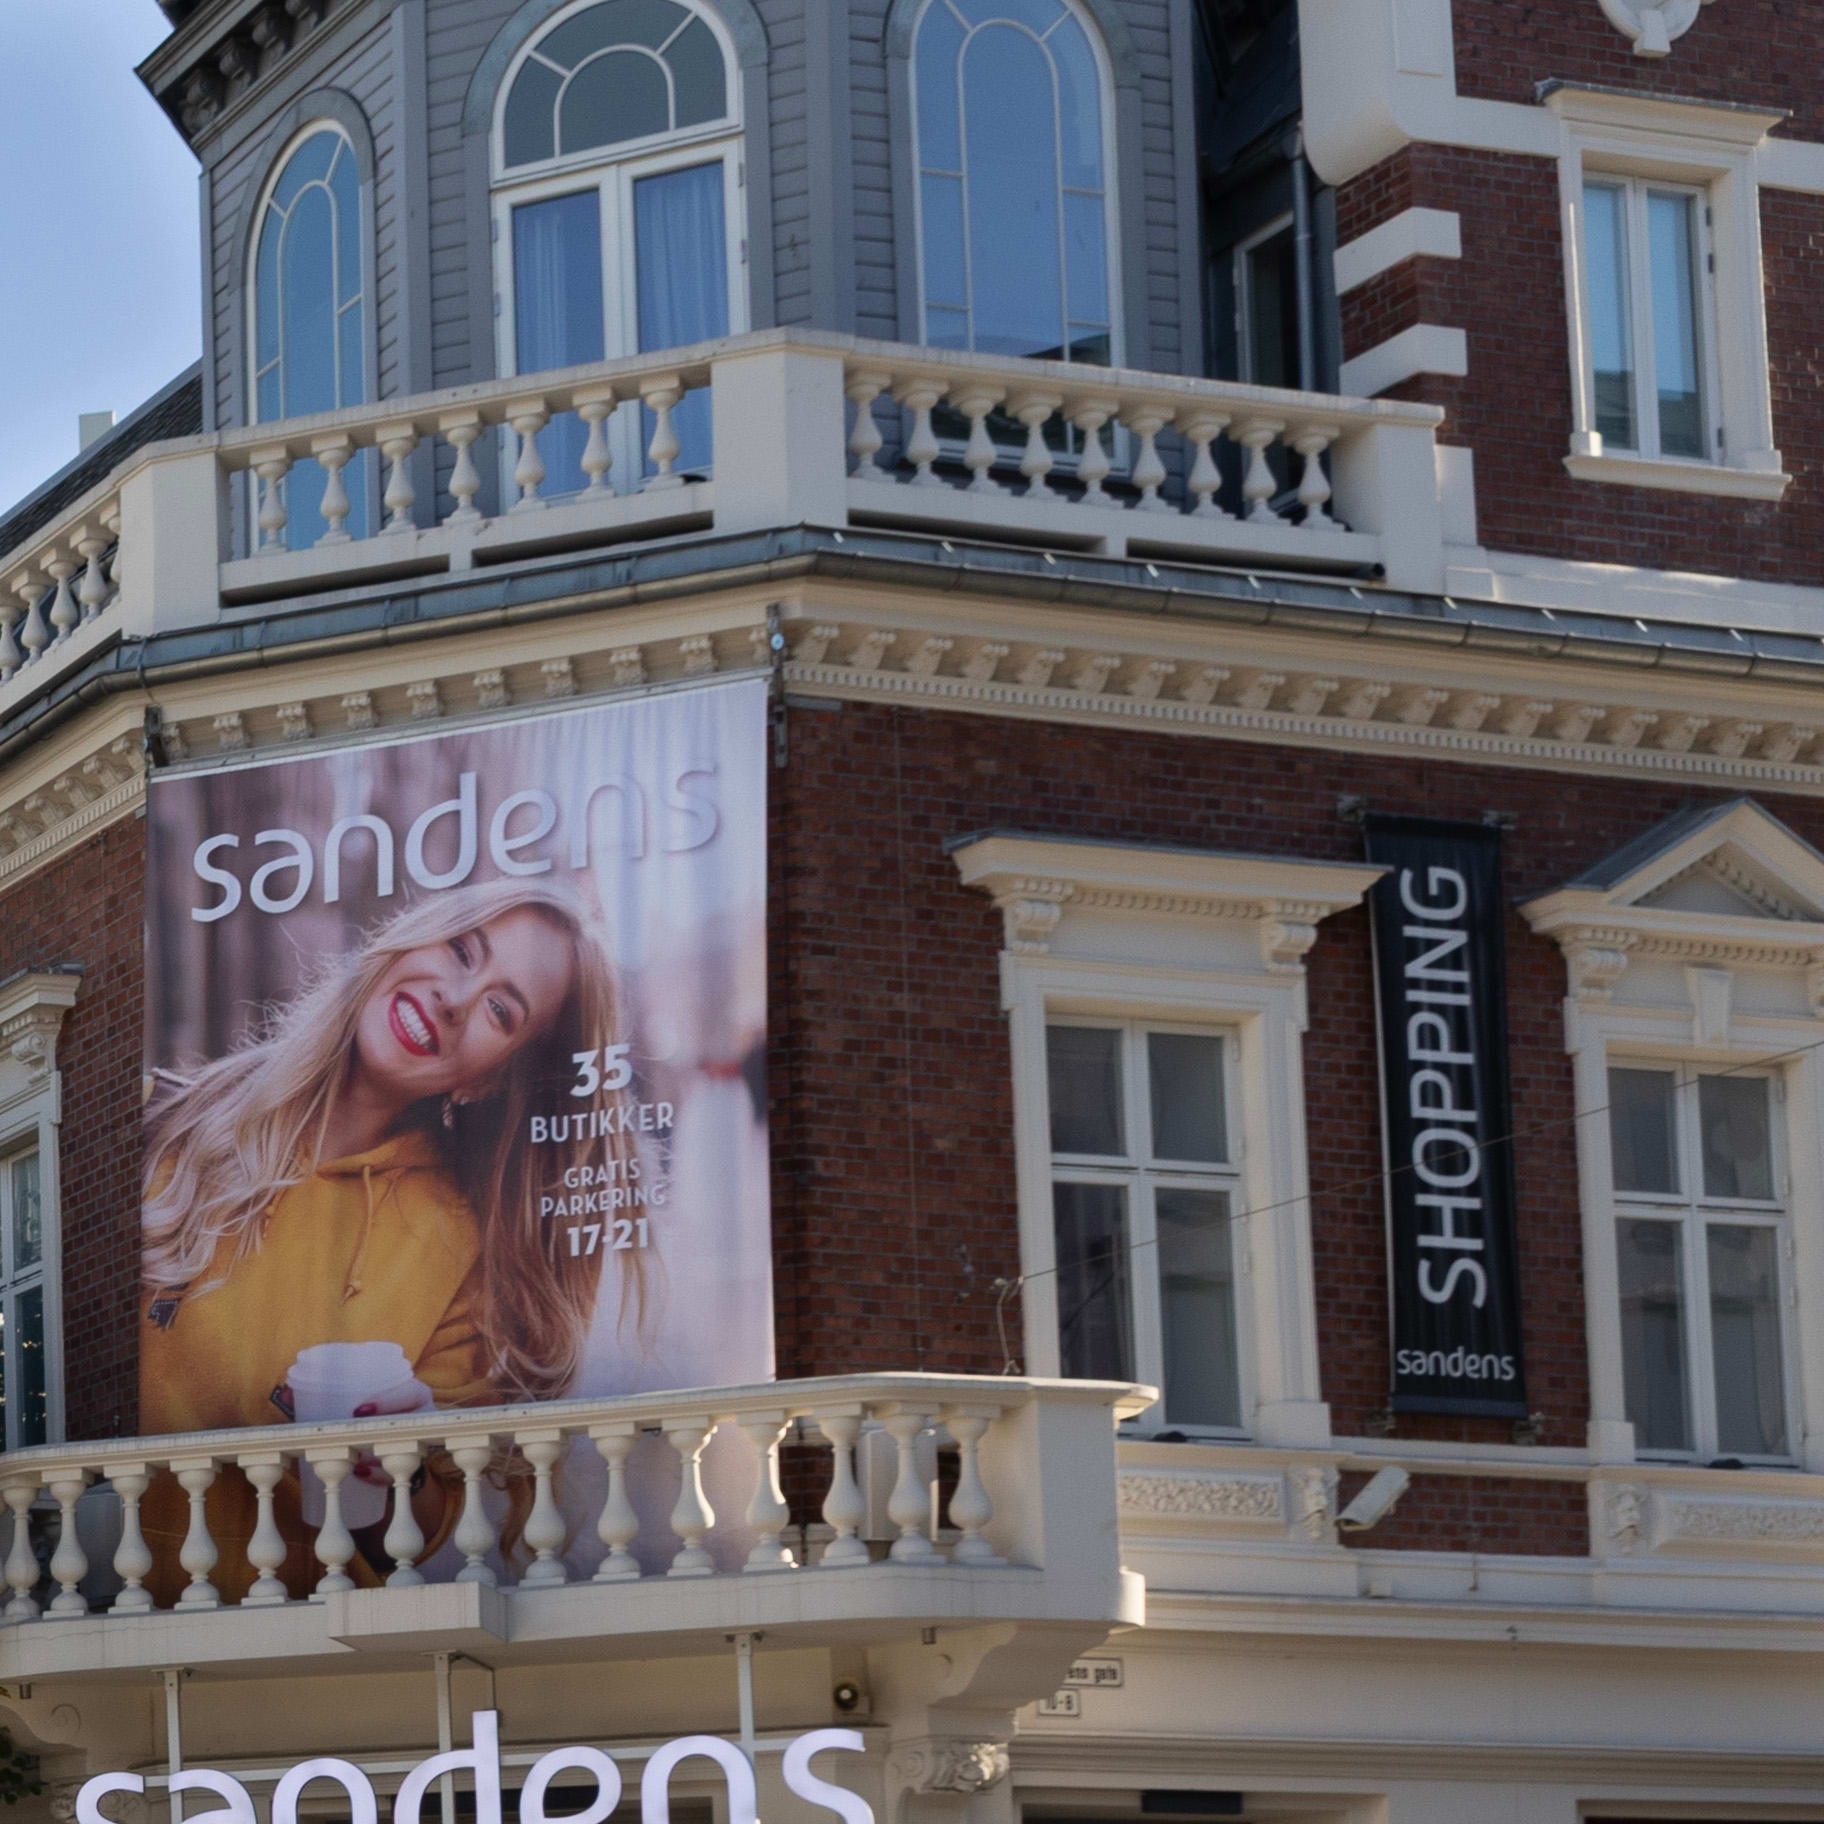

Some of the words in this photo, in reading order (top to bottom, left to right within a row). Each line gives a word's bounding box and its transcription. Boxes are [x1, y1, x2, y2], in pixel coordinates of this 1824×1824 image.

[190, 763, 720, 924] sandens
[570, 1043, 633, 1098] 35
[1400, 866, 1488, 1308] SHOPPING
[530, 1101, 675, 1144] BUTIKKER
[563, 1157, 641, 1189] GRATIS
[540, 1183, 666, 1218] PARKERING
[567, 1217, 650, 1257] 17-21
[1397, 1344, 1515, 1380] sandens
